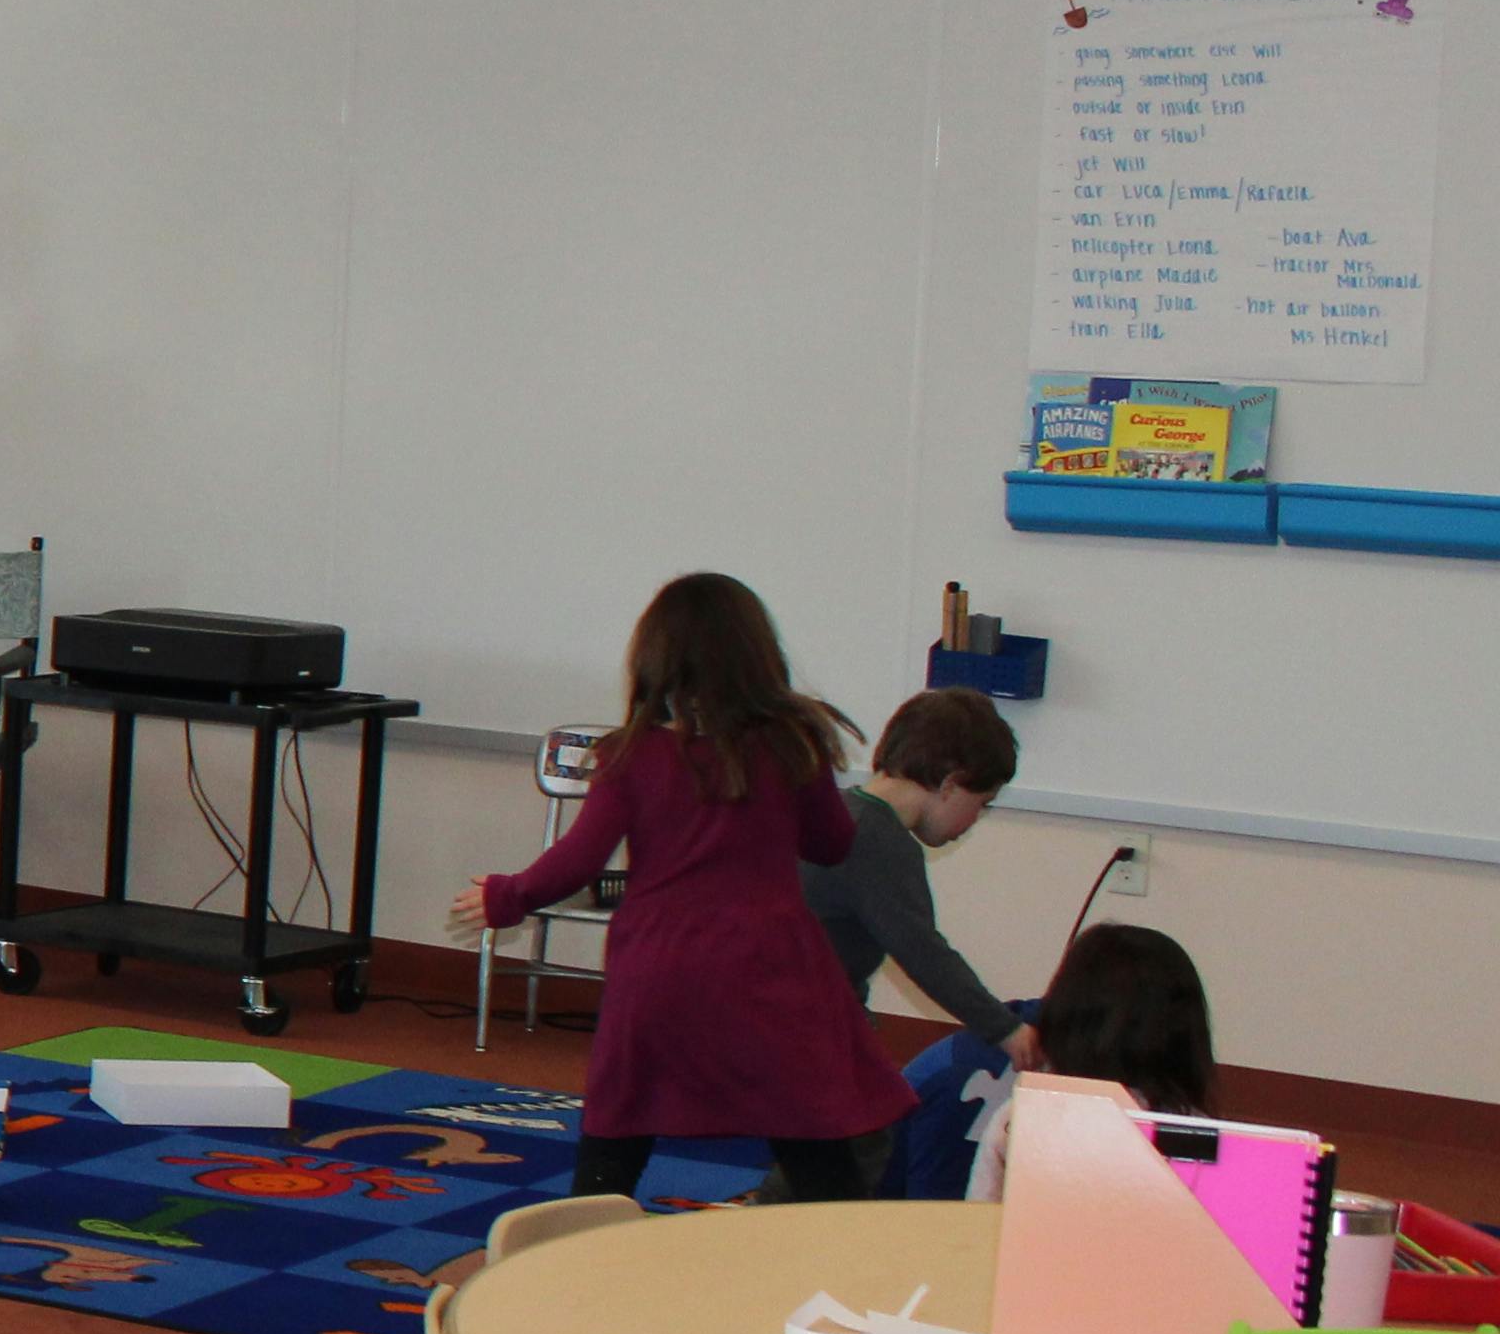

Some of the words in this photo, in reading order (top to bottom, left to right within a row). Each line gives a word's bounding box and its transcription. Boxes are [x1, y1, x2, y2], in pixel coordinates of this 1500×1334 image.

[1075, 48, 1110, 66] going
[1125, 43, 1196, 59] somewhere
[1209, 43, 1237, 58] else
[1253, 43, 1282, 59] Will
[1074, 73, 1124, 96] passing
[1139, 72, 1208, 96] something
[1072, 100, 1123, 114] outside
[1136, 101, 1151, 114] or
[1161, 100, 1201, 114] inside
[1212, 99, 1245, 114] Erin
[1080, 127, 1114, 143] fast
[1134, 129, 1151, 142] or
[1074, 155, 1099, 180] jet
[1113, 156, 1146, 172] Will
[1074, 185, 1104, 199] car
[1071, 213, 1102, 226] van
[1114, 211, 1156, 227] Erin
[1283, 228, 1323, 246] boat
[1337, 228, 1377, 246] Ava
[1072, 238, 1153, 261] helicopter
[1166, 239, 1219, 255] Leona
[1274, 257, 1329, 272] tractor
[1072, 267, 1143, 288] airplane
[1071, 294, 1140, 318] walking
[1247, 297, 1275, 314] hot
[1286, 302, 1309, 316] air
[1321, 302, 1380, 318] balloon
[1069, 321, 1108, 337] train
[1041, 406, 1109, 424] AMAZING
[1130, 414, 1187, 427] Curious
[1043, 421, 1105, 441] AIRPLANES
[1154, 428, 1206, 443] George
